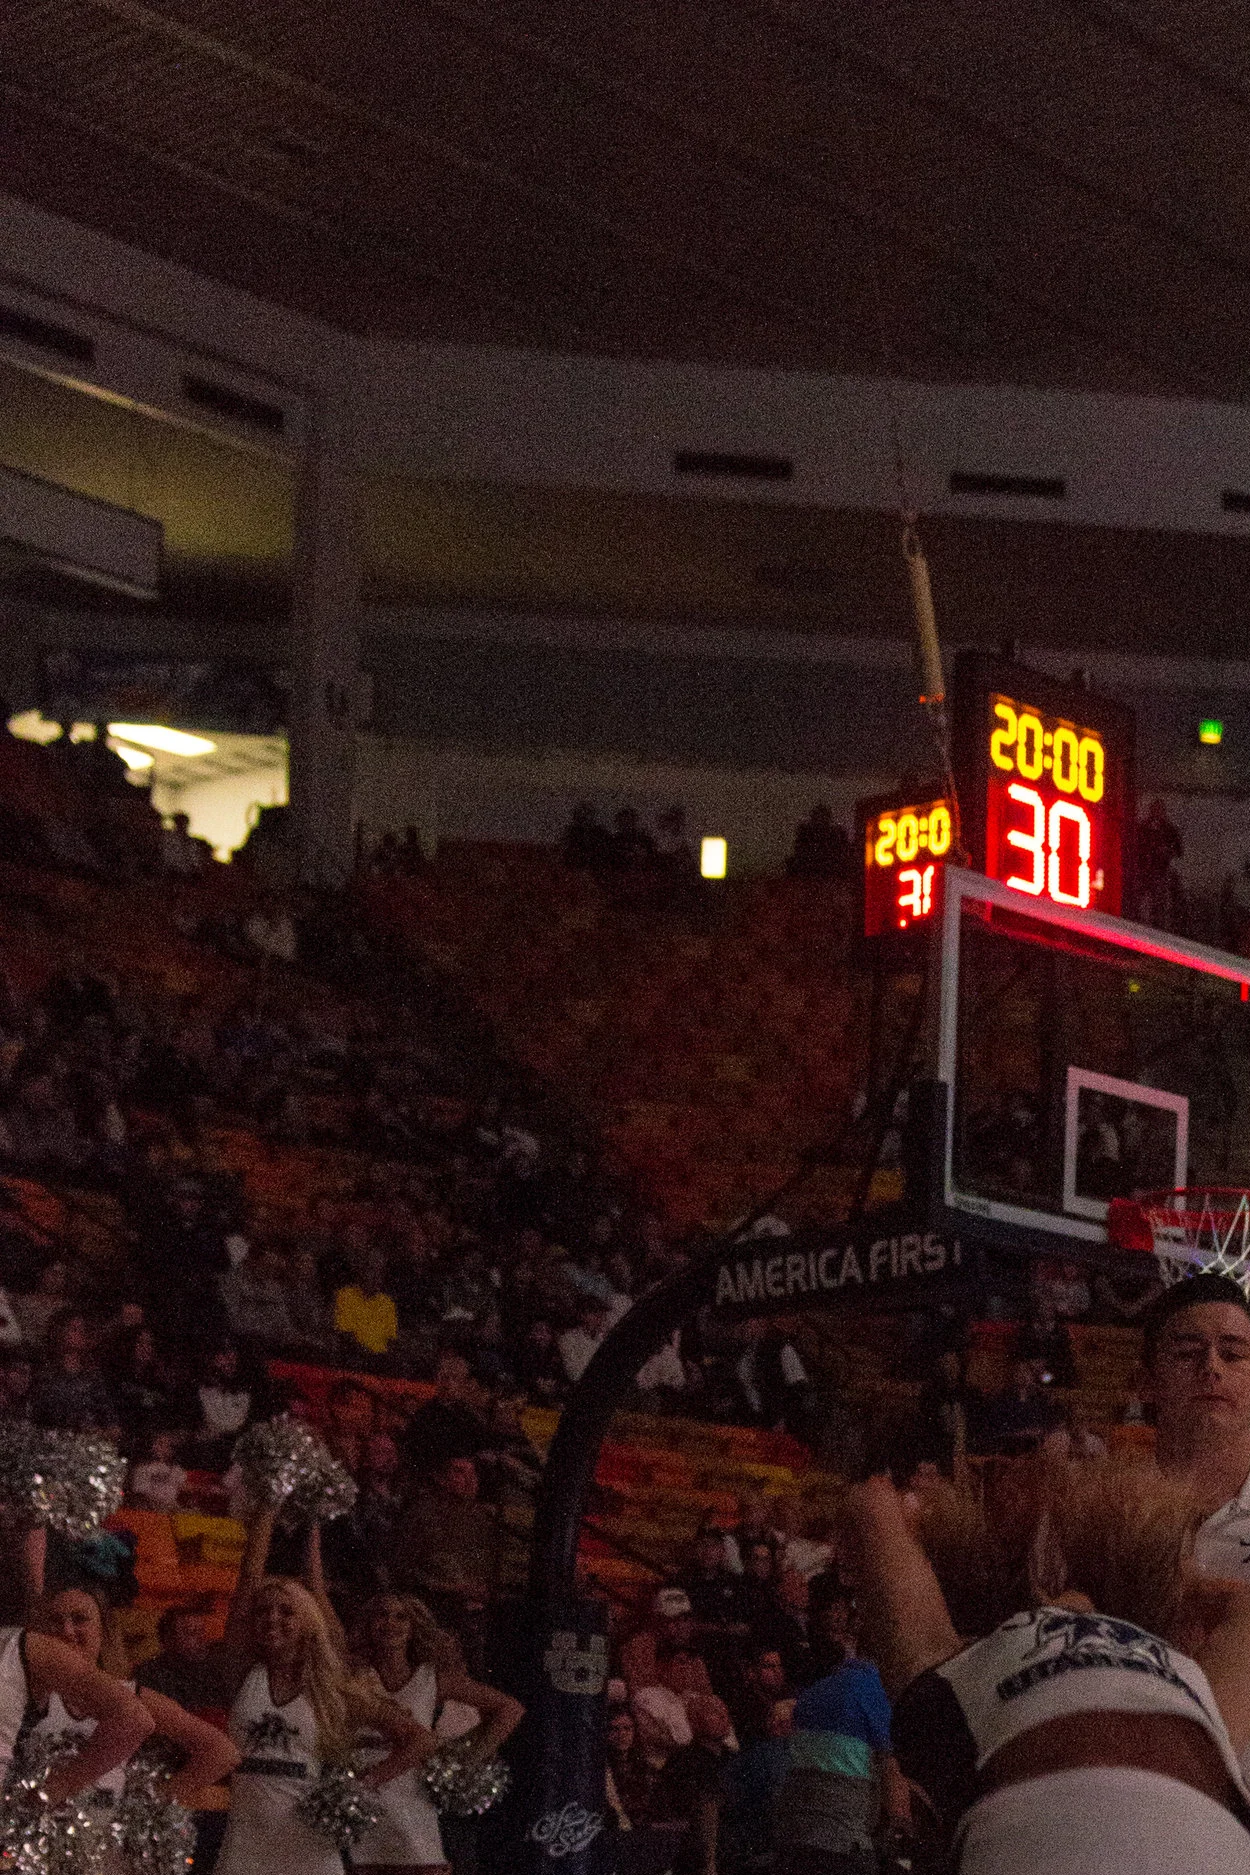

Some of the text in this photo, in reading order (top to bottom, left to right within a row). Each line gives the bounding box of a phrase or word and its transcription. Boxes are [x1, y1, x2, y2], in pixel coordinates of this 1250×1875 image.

[990, 703, 1105, 803] 20:00
[874, 806, 951, 867] 20:0
[1006, 782, 1092, 910] 30
[715, 1246, 864, 1306] AMERICA
